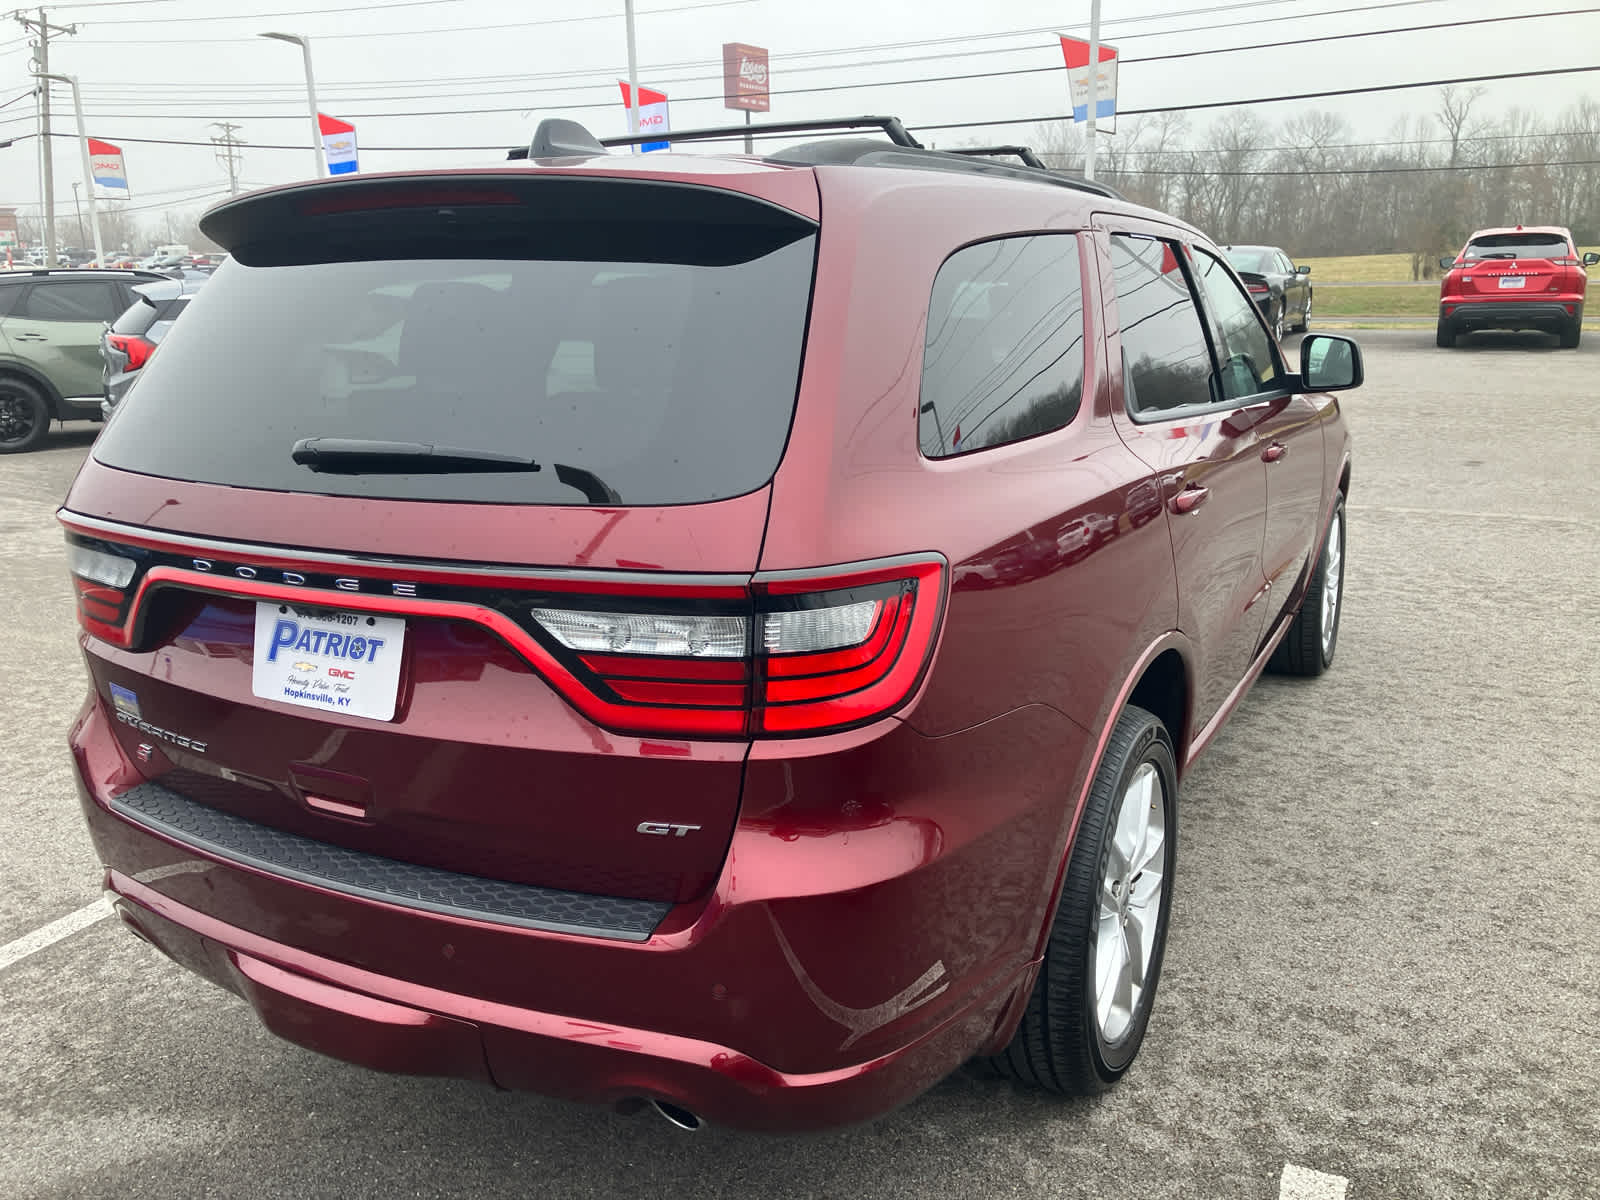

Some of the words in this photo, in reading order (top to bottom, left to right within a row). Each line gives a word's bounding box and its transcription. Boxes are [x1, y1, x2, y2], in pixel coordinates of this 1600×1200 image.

[192, 558, 417, 597] DODGE
[266, 618, 384, 663] PATRIOT
[328, 667, 355, 680] GMC
[284, 687, 336, 704] Hopkinsville,
[337, 696, 351, 706] KY
[636, 821, 701, 837] GT
